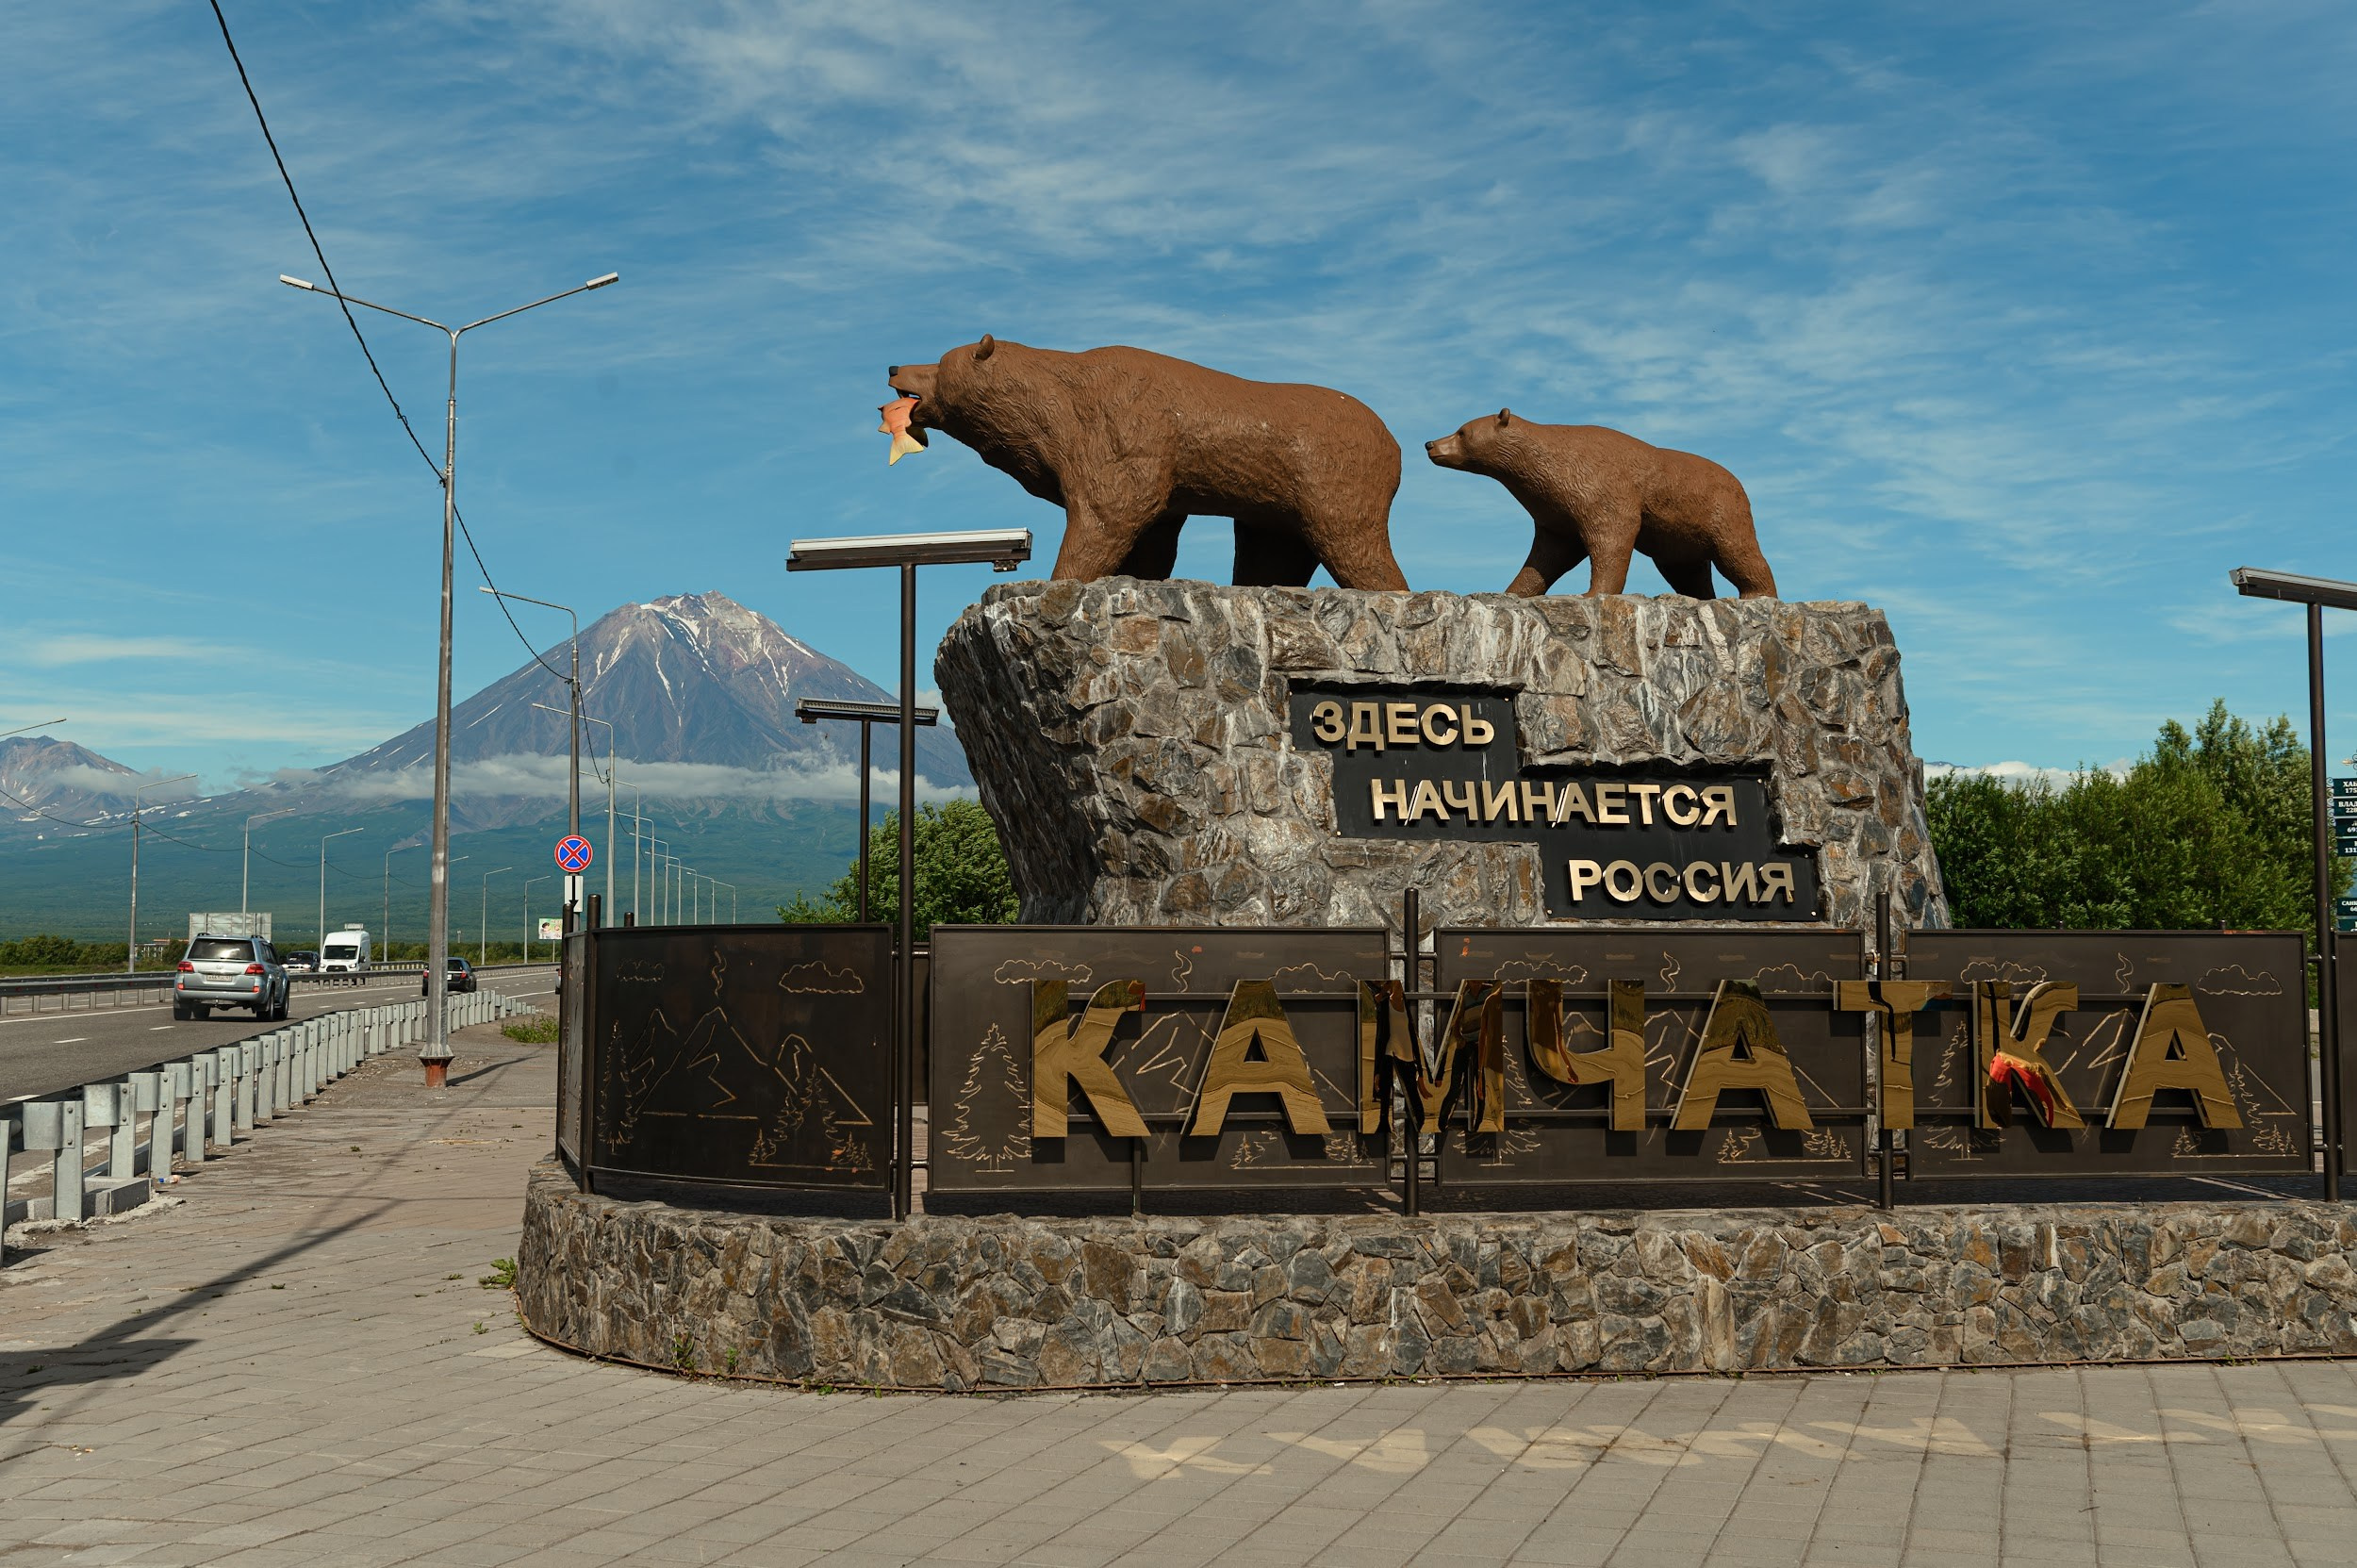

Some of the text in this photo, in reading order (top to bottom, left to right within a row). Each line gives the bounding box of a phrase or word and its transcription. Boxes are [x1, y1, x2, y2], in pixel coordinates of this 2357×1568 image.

[1310, 701, 1495, 751] ЗДЕСЬ
[1371, 779, 1738, 827] НАЧИНАЕТСЯ
[1568, 859, 1795, 903] РОССИЯ
[1032, 978, 2244, 1137] КАМЧАТКА
